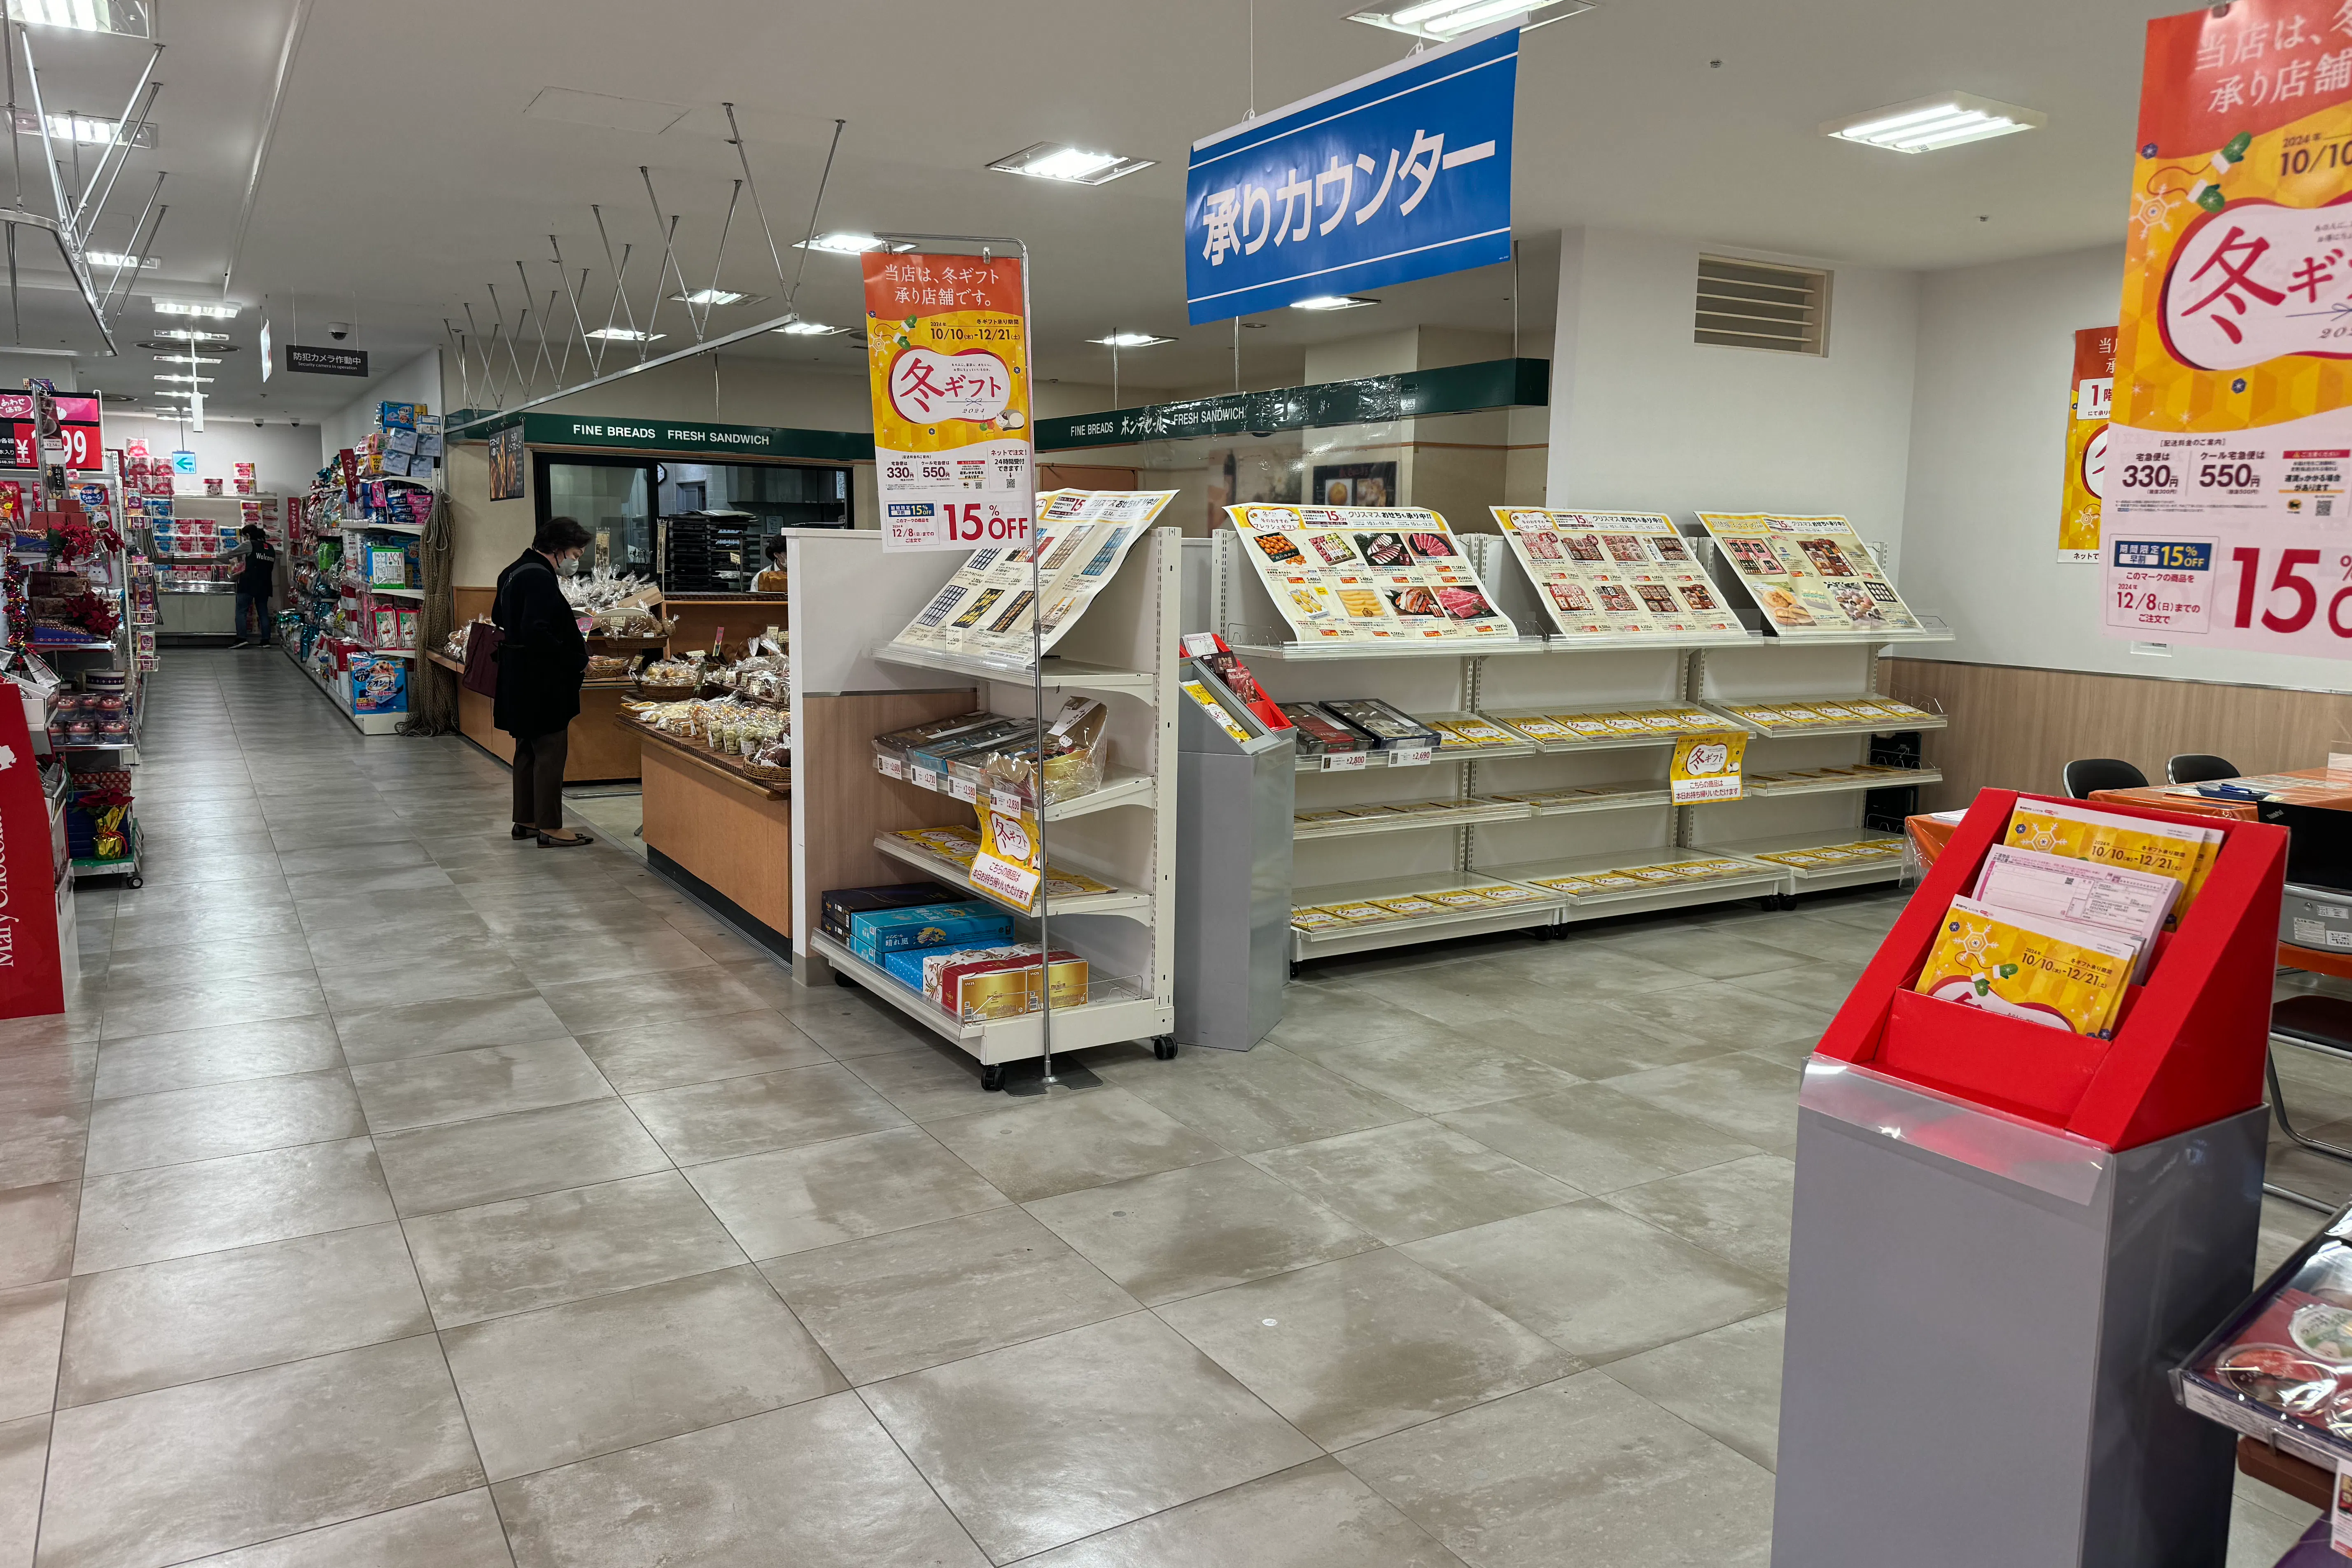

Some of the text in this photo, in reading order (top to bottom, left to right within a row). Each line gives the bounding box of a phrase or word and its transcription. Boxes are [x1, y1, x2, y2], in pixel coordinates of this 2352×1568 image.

[1202, 130, 1496, 266] 承りカウンター
[885, 264, 999, 285] 当店は、冬ギフト
[2181, 226, 2352, 345] 冬ギ
[895, 287, 991, 306] 承り店舗です。
[2099, 338, 2119, 354] 当
[293, 352, 361, 365] 防犯カメラ作動中
[900, 357, 1001, 413] 冬ギフト
[1071, 425, 1085, 437] FINE
[1087, 422, 1113, 435] BREADS
[1174, 413, 1199, 426] FRESH
[1201, 406, 1245, 423] SANDWICH
[573, 424, 770, 445] FINE BREADS FRESH SANDWICH
[2136, 451, 2265, 462] 宅急便は クール宅急便は
[887, 467, 950, 478] 330円 550円
[2122, 464, 2260, 488] 330円 550円
[911, 505, 922, 515] 15
[943, 503, 999, 541] 15 %
[988, 518, 1028, 540] OFF
[2161, 546, 2184, 566] 15
[2184, 558, 2204, 568] OFF
[2126, 572, 2194, 583] このマークの商品を
[2232, 547, 2317, 633] 15
[2139, 614, 2170, 623] ご注文で
[1689, 747, 1723, 770] 冬ギフト
[1676, 788, 1738, 800] 本日お持ち帰りいただけます
[1690, 780, 1723, 789] こちらの商品は
[995, 817, 1027, 849] 冬ギフト
[989, 862, 1021, 882] こちらの商品は
[972, 868, 1029, 901] 本日お持ち帰りいただけます
[885, 937, 908, 947] 晴れ風
